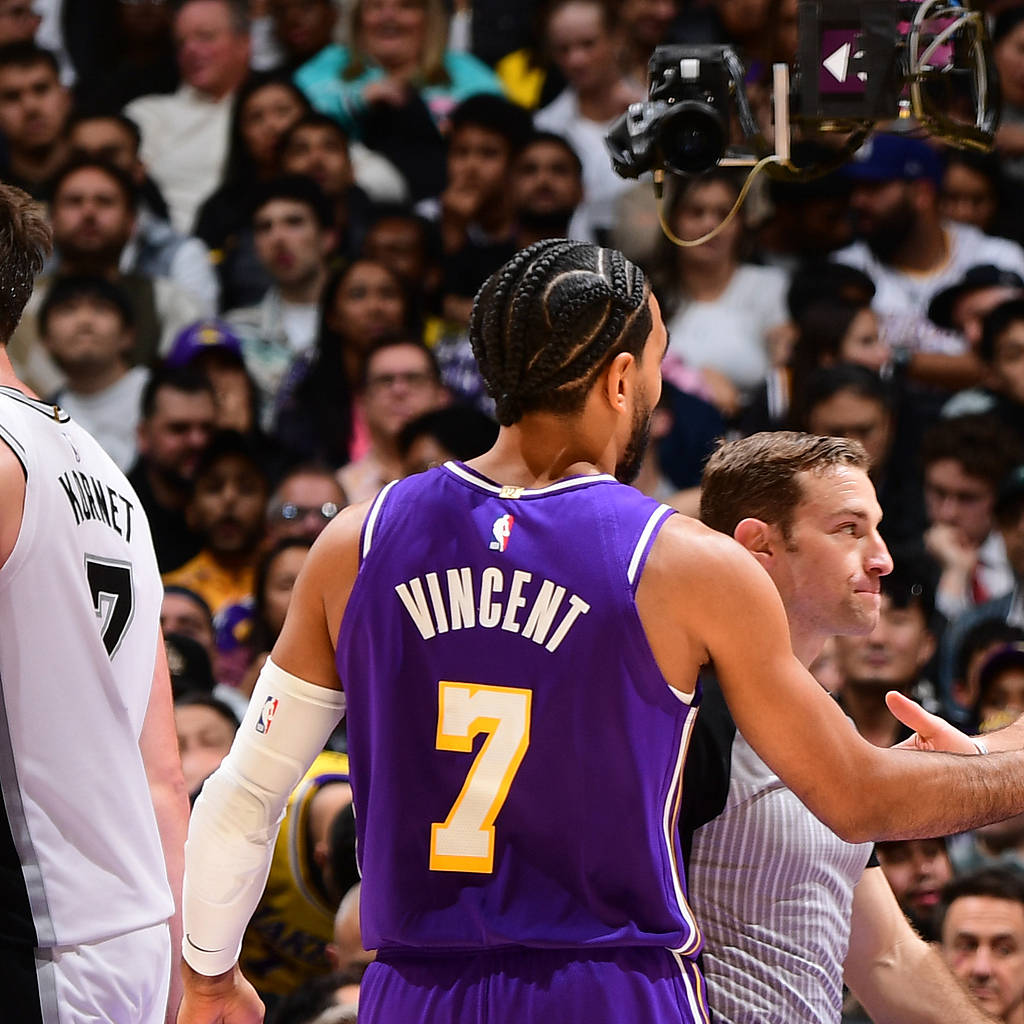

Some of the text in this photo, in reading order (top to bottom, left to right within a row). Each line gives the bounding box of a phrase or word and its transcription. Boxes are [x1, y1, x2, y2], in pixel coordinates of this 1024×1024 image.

[58, 470, 134, 543] KORNET
[84, 552, 135, 661] 7
[395, 567, 590, 652] VINCENT
[429, 681, 532, 873] 7
